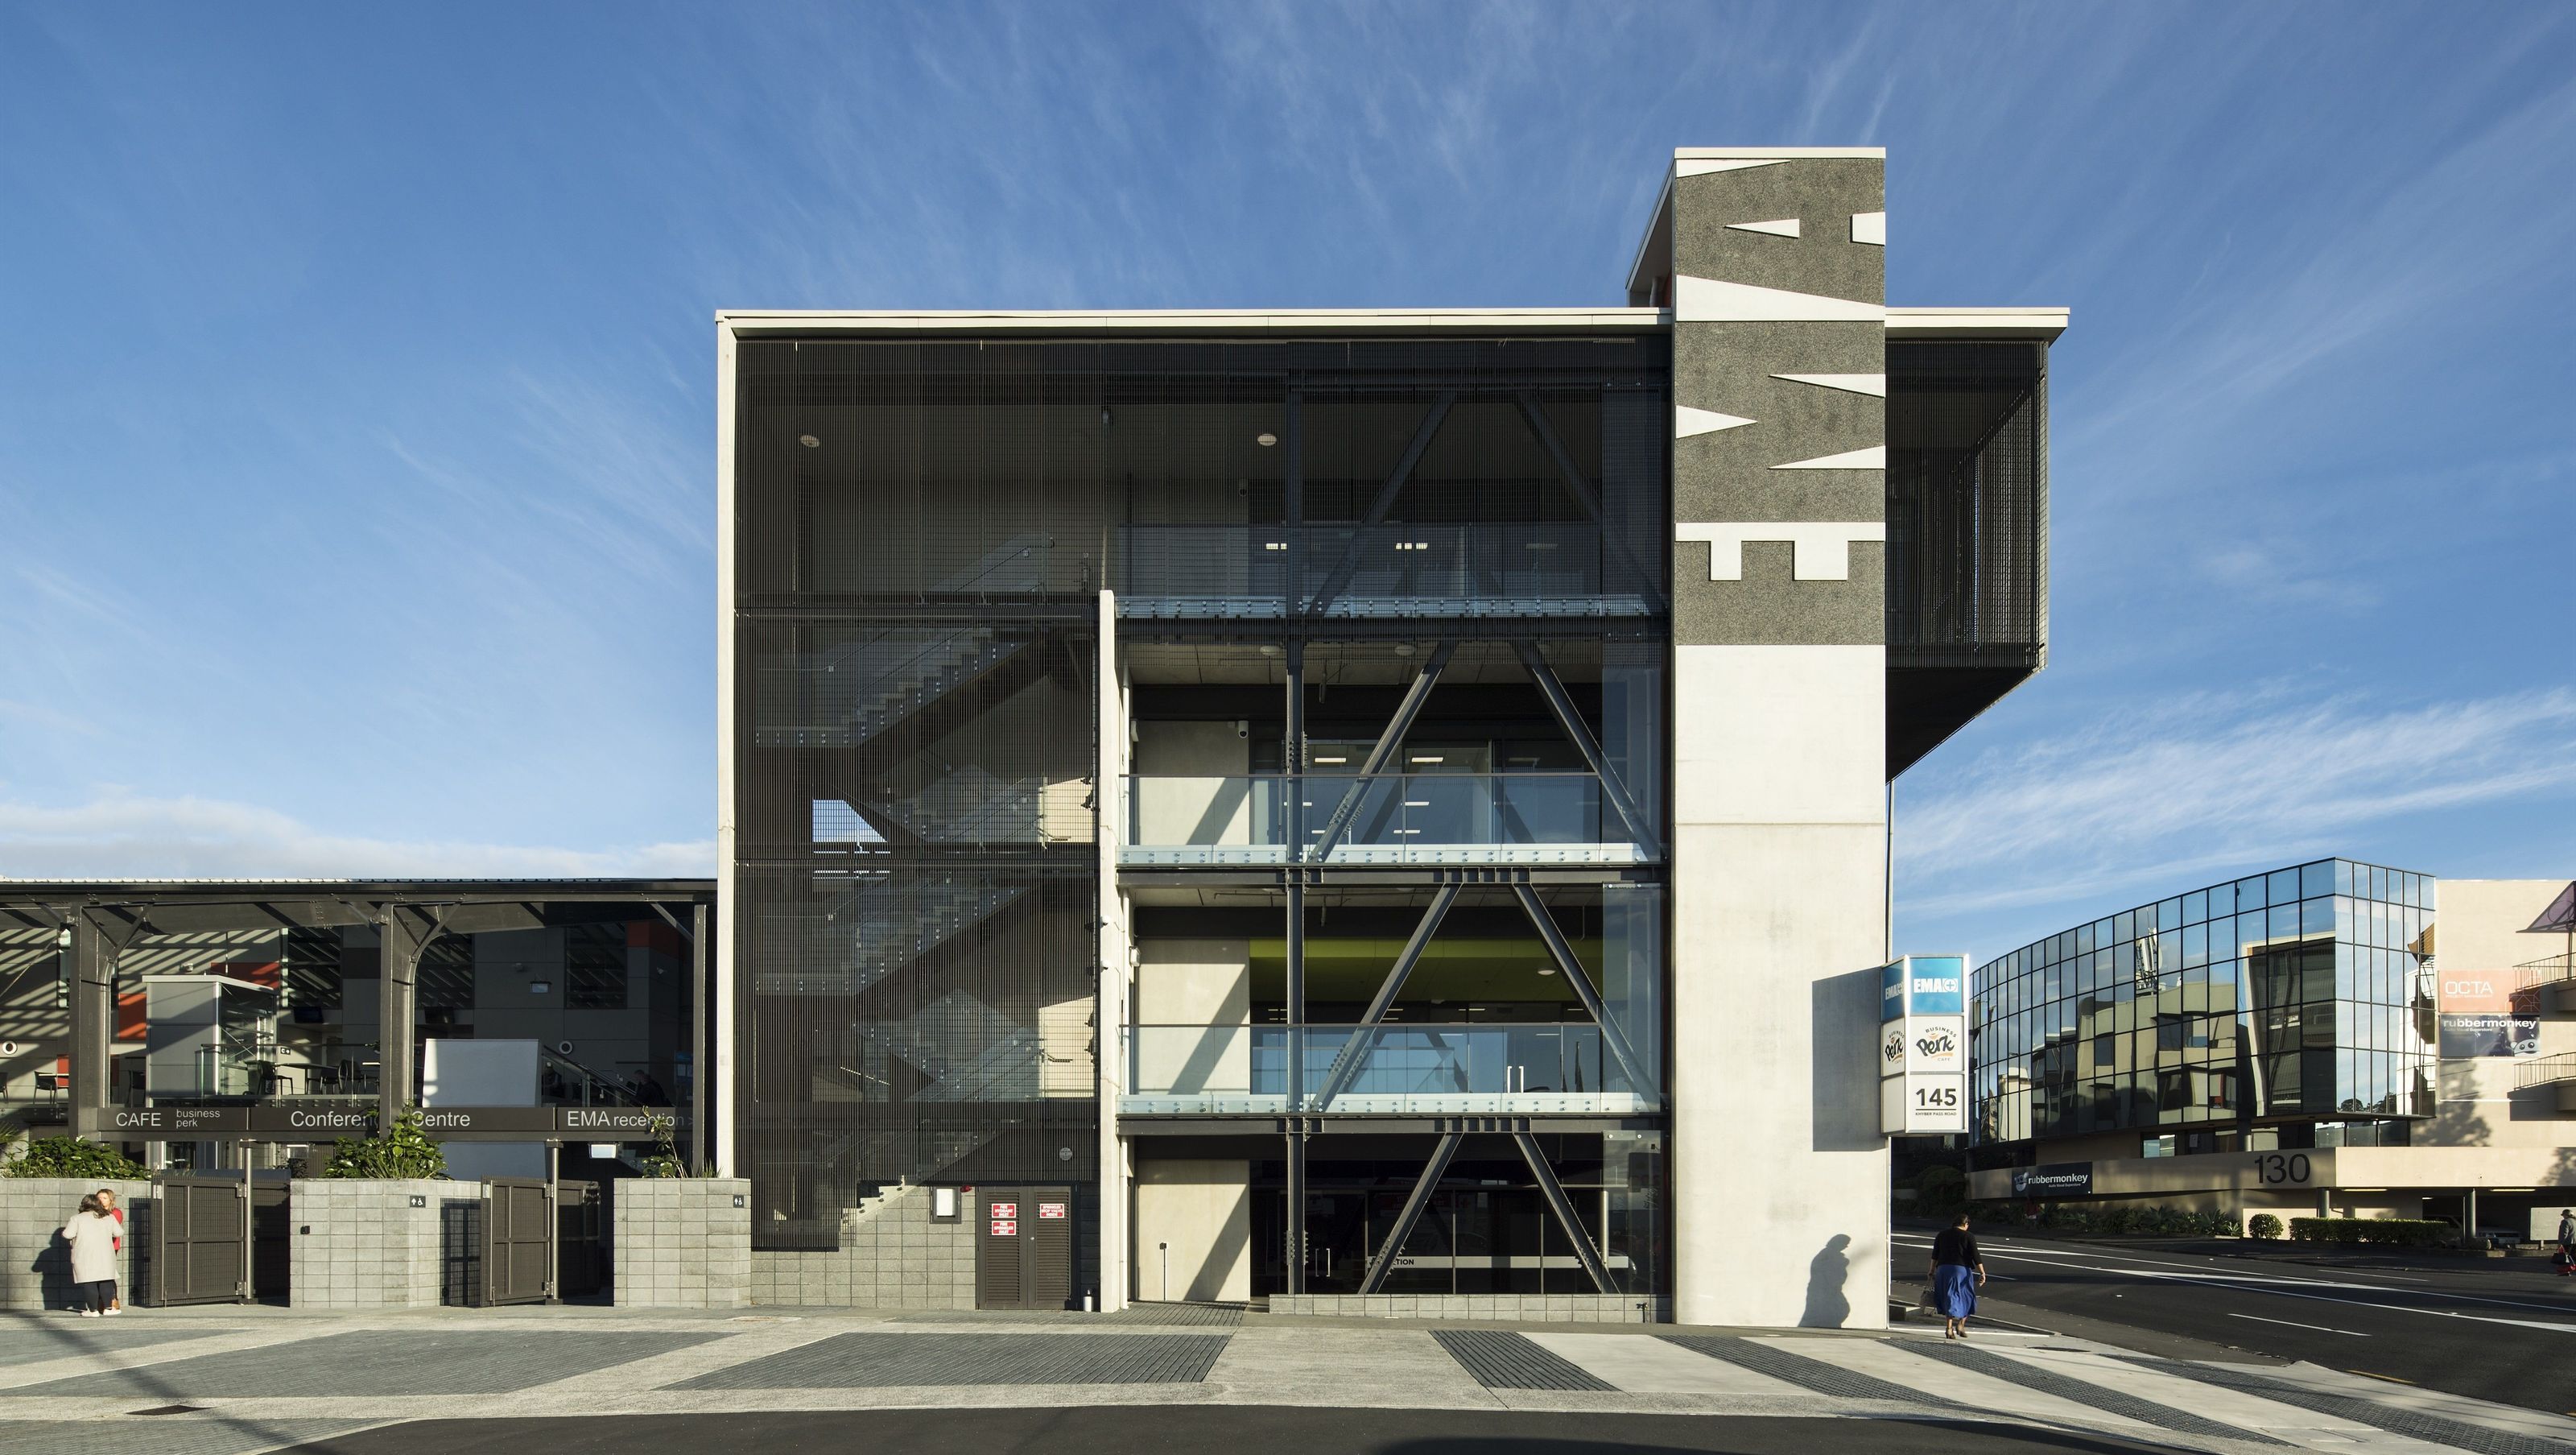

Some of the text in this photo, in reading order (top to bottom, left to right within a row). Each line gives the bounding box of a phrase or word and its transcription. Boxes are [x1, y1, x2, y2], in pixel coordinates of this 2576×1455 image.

[2445, 981, 2493, 994] OCTA
[2443, 1019, 2537, 1029] rubbermonkey
[1926, 1027, 1957, 1038] BUSINESS
[1885, 1037, 1903, 1061] Perk
[1916, 1035, 1955, 1056] Perk
[1916, 1088, 1957, 1106] 145
[116, 1112, 161, 1126] CAFE
[176, 1109, 221, 1118] business
[291, 1110, 470, 1126] Conferen Centre
[568, 1110, 610, 1126] EMA
[176, 1118, 198, 1129] perk
[2254, 1153, 2310, 1184] 130
[2028, 1173, 2088, 1184] rubbermonkey
